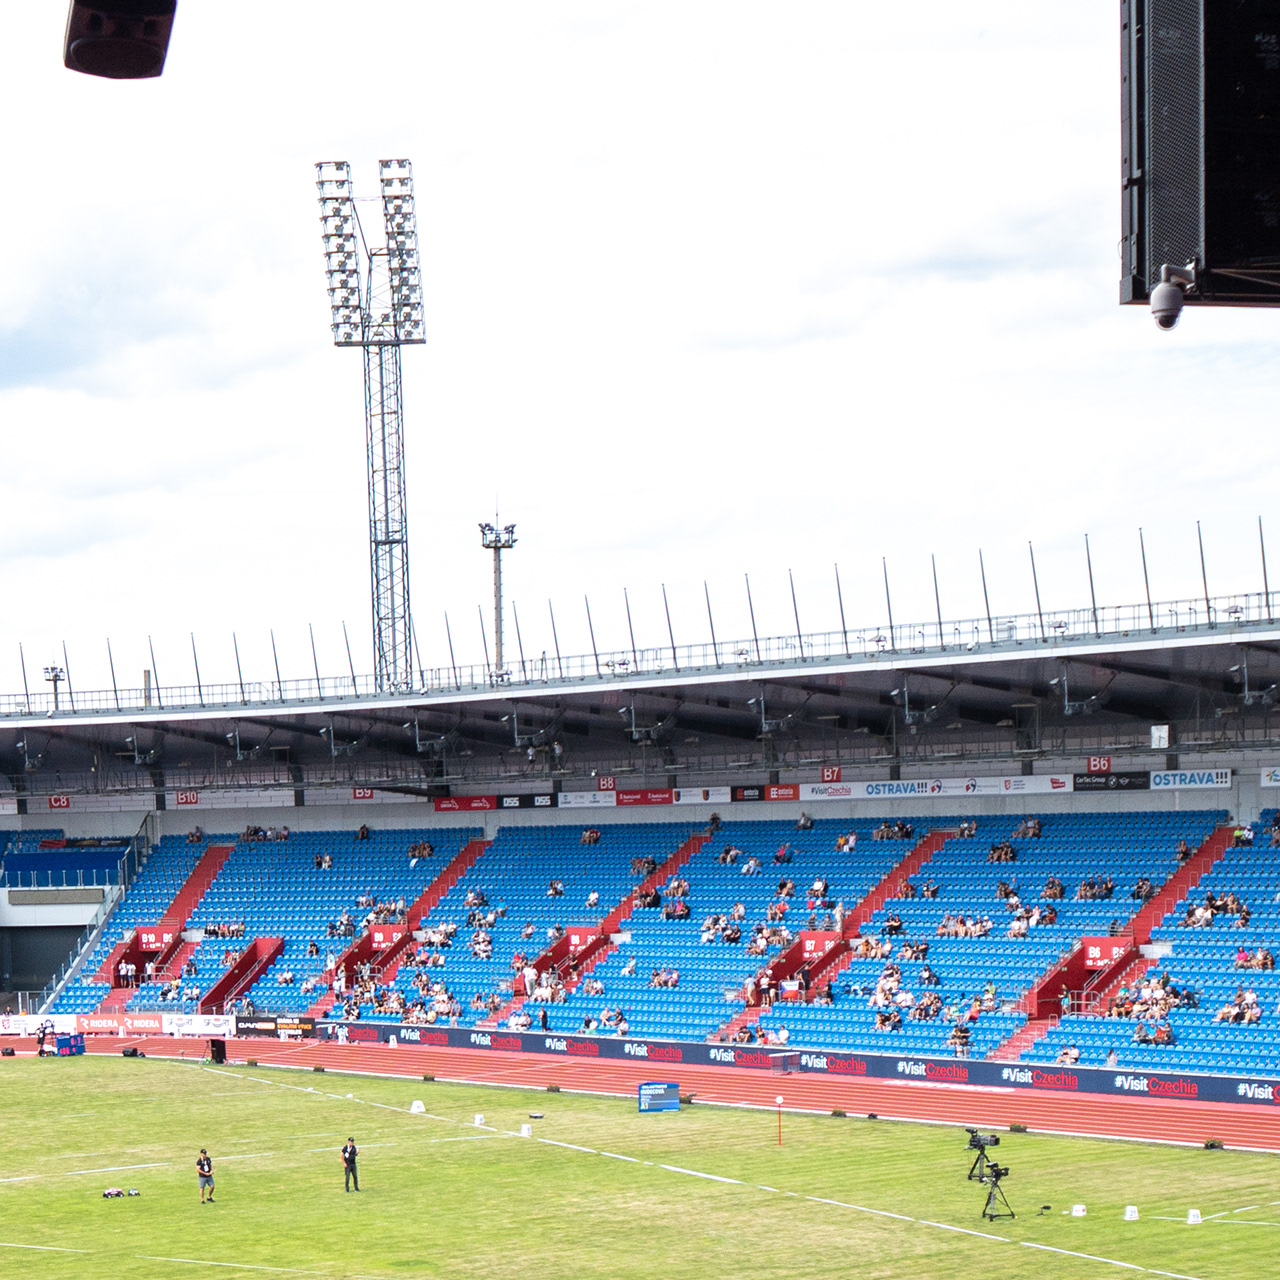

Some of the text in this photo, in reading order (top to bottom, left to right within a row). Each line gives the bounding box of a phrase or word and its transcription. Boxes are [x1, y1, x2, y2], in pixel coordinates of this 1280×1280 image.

[1090, 757, 1108, 770] B6
[824, 768, 839, 780] B7
[1153, 772, 1229, 786] OSTRAVA!!!
[600, 778, 614, 789] B8
[866, 783, 928, 795] OSTRAVA!!!
[811, 785, 852, 796] #VisitCzechia
[51, 796, 68, 806] C8
[178, 792, 197, 803] B10
[142, 934, 156, 943] B10
[806, 940, 816, 951] B7
[1089, 946, 1101, 957] B6
[89, 1019, 119, 1028] RIDERA
[132, 1019, 160, 1028] RIDERA
[400, 1029, 449, 1043] #VisitCzechia
[471, 1033, 522, 1047] #VisitCzechia
[545, 1038, 600, 1052] #VisitCzechia
[624, 1043, 683, 1057] #VisitCzechia
[710, 1049, 772, 1063] #VisitCzechia
[801, 1055, 866, 1072] #VisitCzechia
[898, 1061, 968, 1077] #VisitCzechia
[1002, 1067, 1078, 1085] #VisitCzechia
[1115, 1075, 1198, 1095] #VisitCzechia
